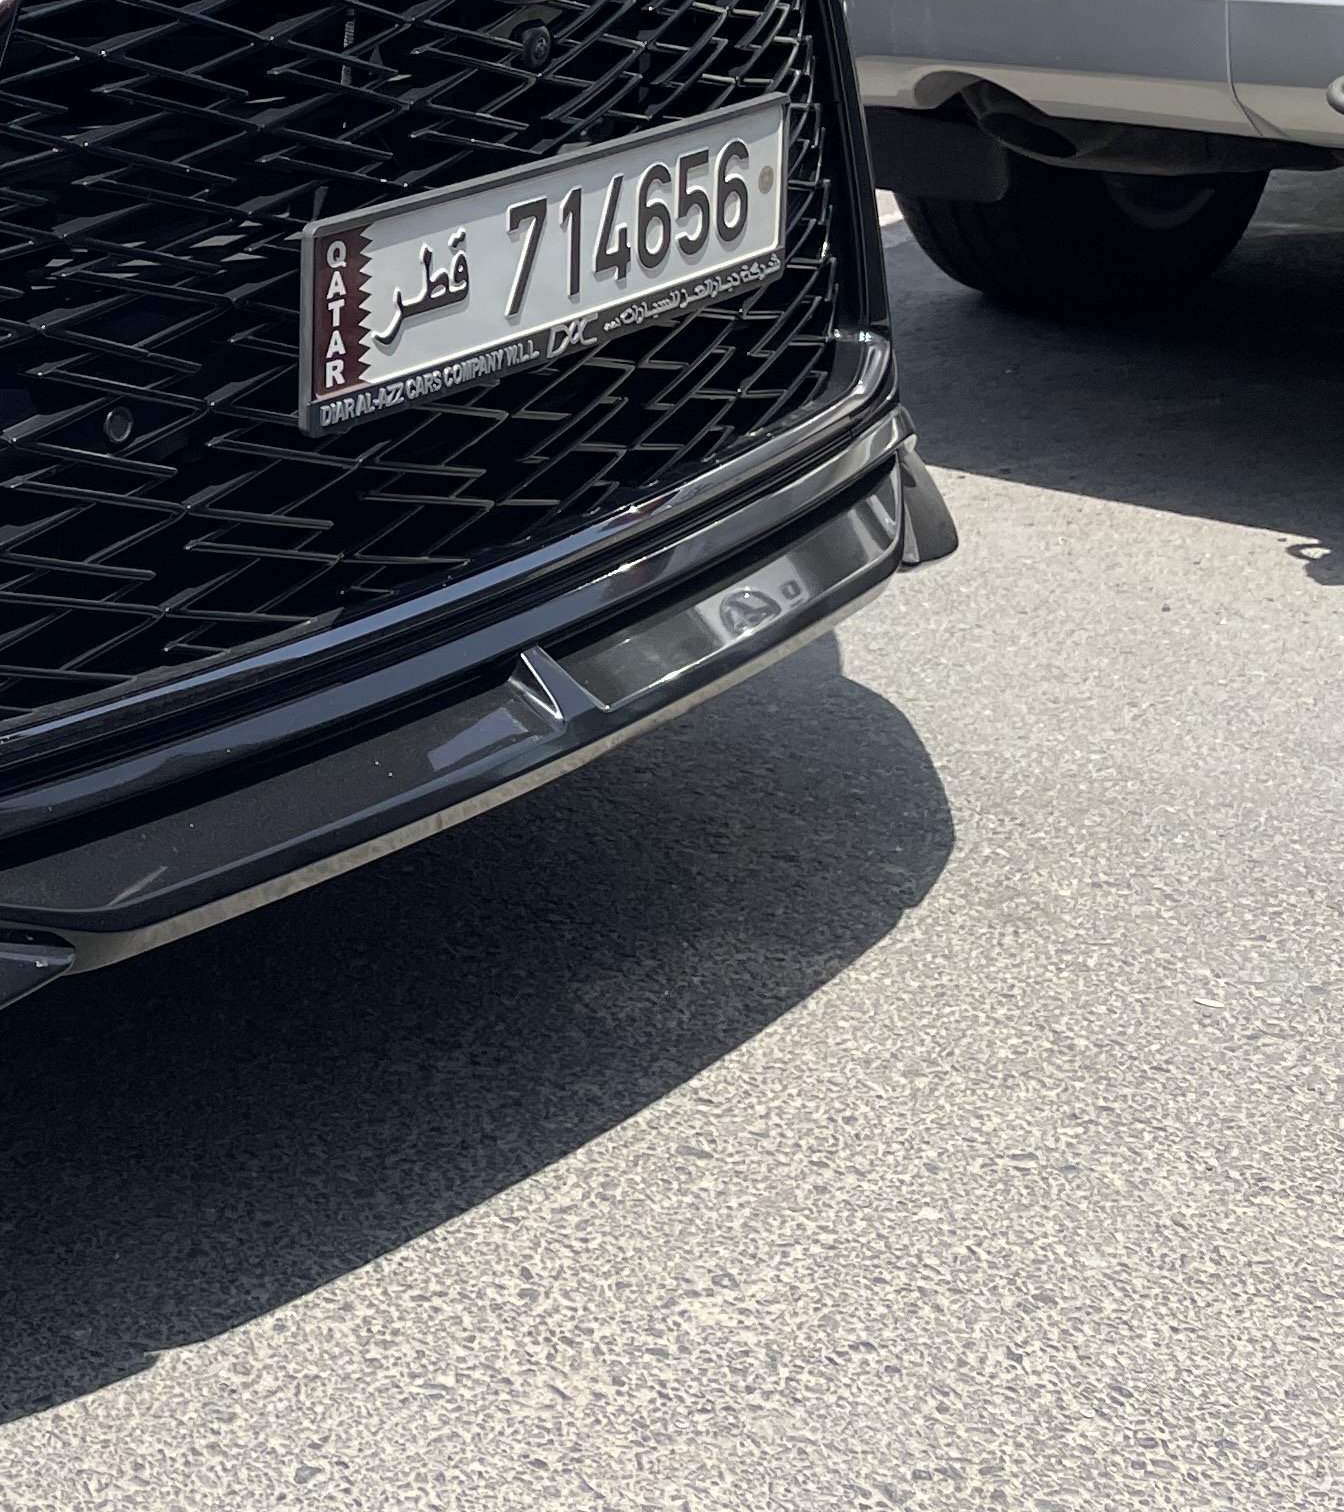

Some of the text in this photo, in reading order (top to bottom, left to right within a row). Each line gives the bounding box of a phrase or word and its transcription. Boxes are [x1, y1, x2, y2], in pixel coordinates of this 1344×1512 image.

[370, 227, 470, 345] قطر
[505, 137, 750, 318] 714656
[324, 239, 348, 389] QATAR
[406, 369, 443, 399] CARS
[443, 349, 504, 387] COMPANY
